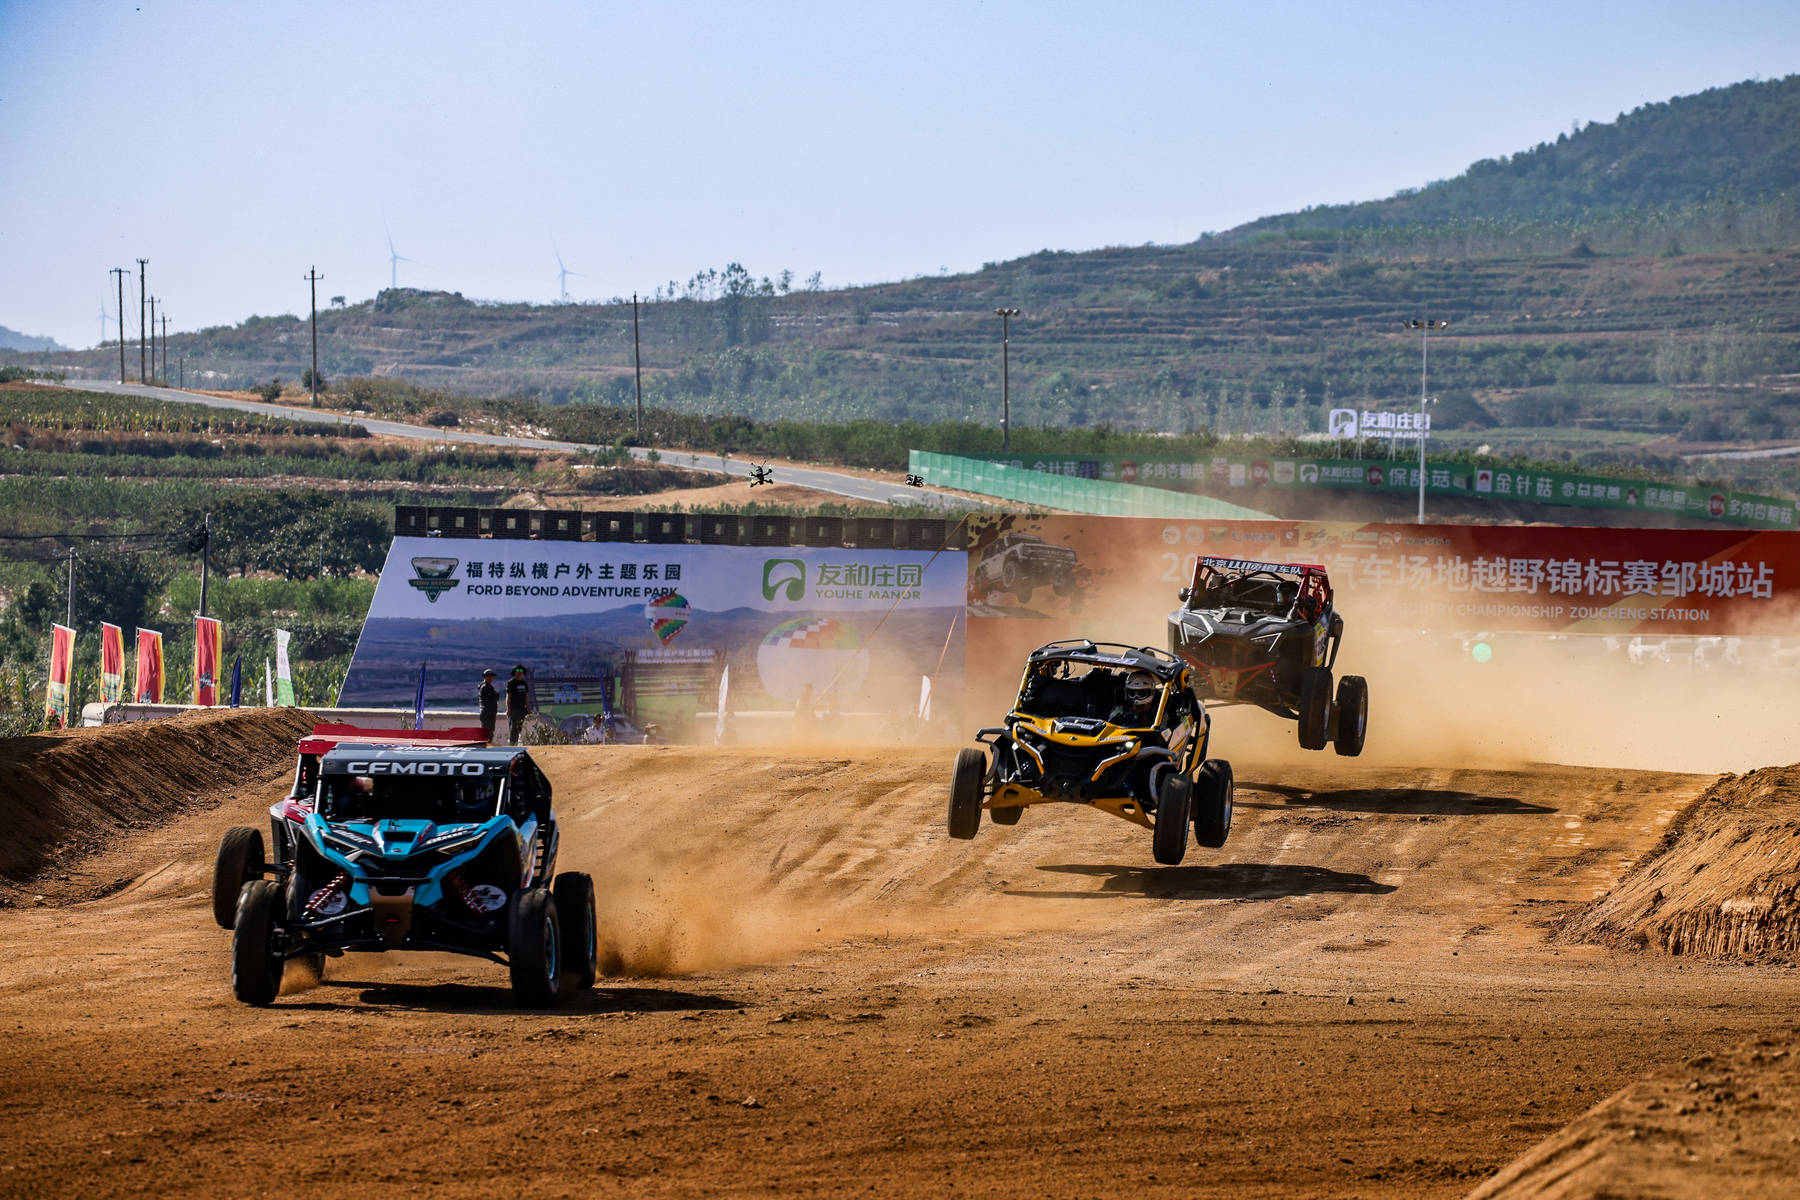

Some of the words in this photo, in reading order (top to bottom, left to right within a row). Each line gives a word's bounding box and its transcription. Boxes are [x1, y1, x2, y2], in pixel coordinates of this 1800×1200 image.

[1361, 411, 1431, 430] 友和庄园
[1389, 468, 1450, 488] 保龄菇
[1496, 473, 1553, 497] 金针菇
[466, 562, 681, 580] 福特纵横户外主题乐园
[816, 563, 922, 587] 友和庄园
[467, 585, 503, 595] FORD
[505, 585, 559, 597] BEYOND
[562, 587, 640, 597] ADVENTURE
[644, 587, 677, 597] PARK
[816, 589, 862, 599] YOUHE
[869, 590, 920, 600] MANOR
[1457, 604, 1563, 618] CHAMPIONSHIP
[1570, 606, 1647, 620] ZOUCHENG
[1650, 608, 1710, 621] STATION
[347, 762, 485, 776] CFMOTO
